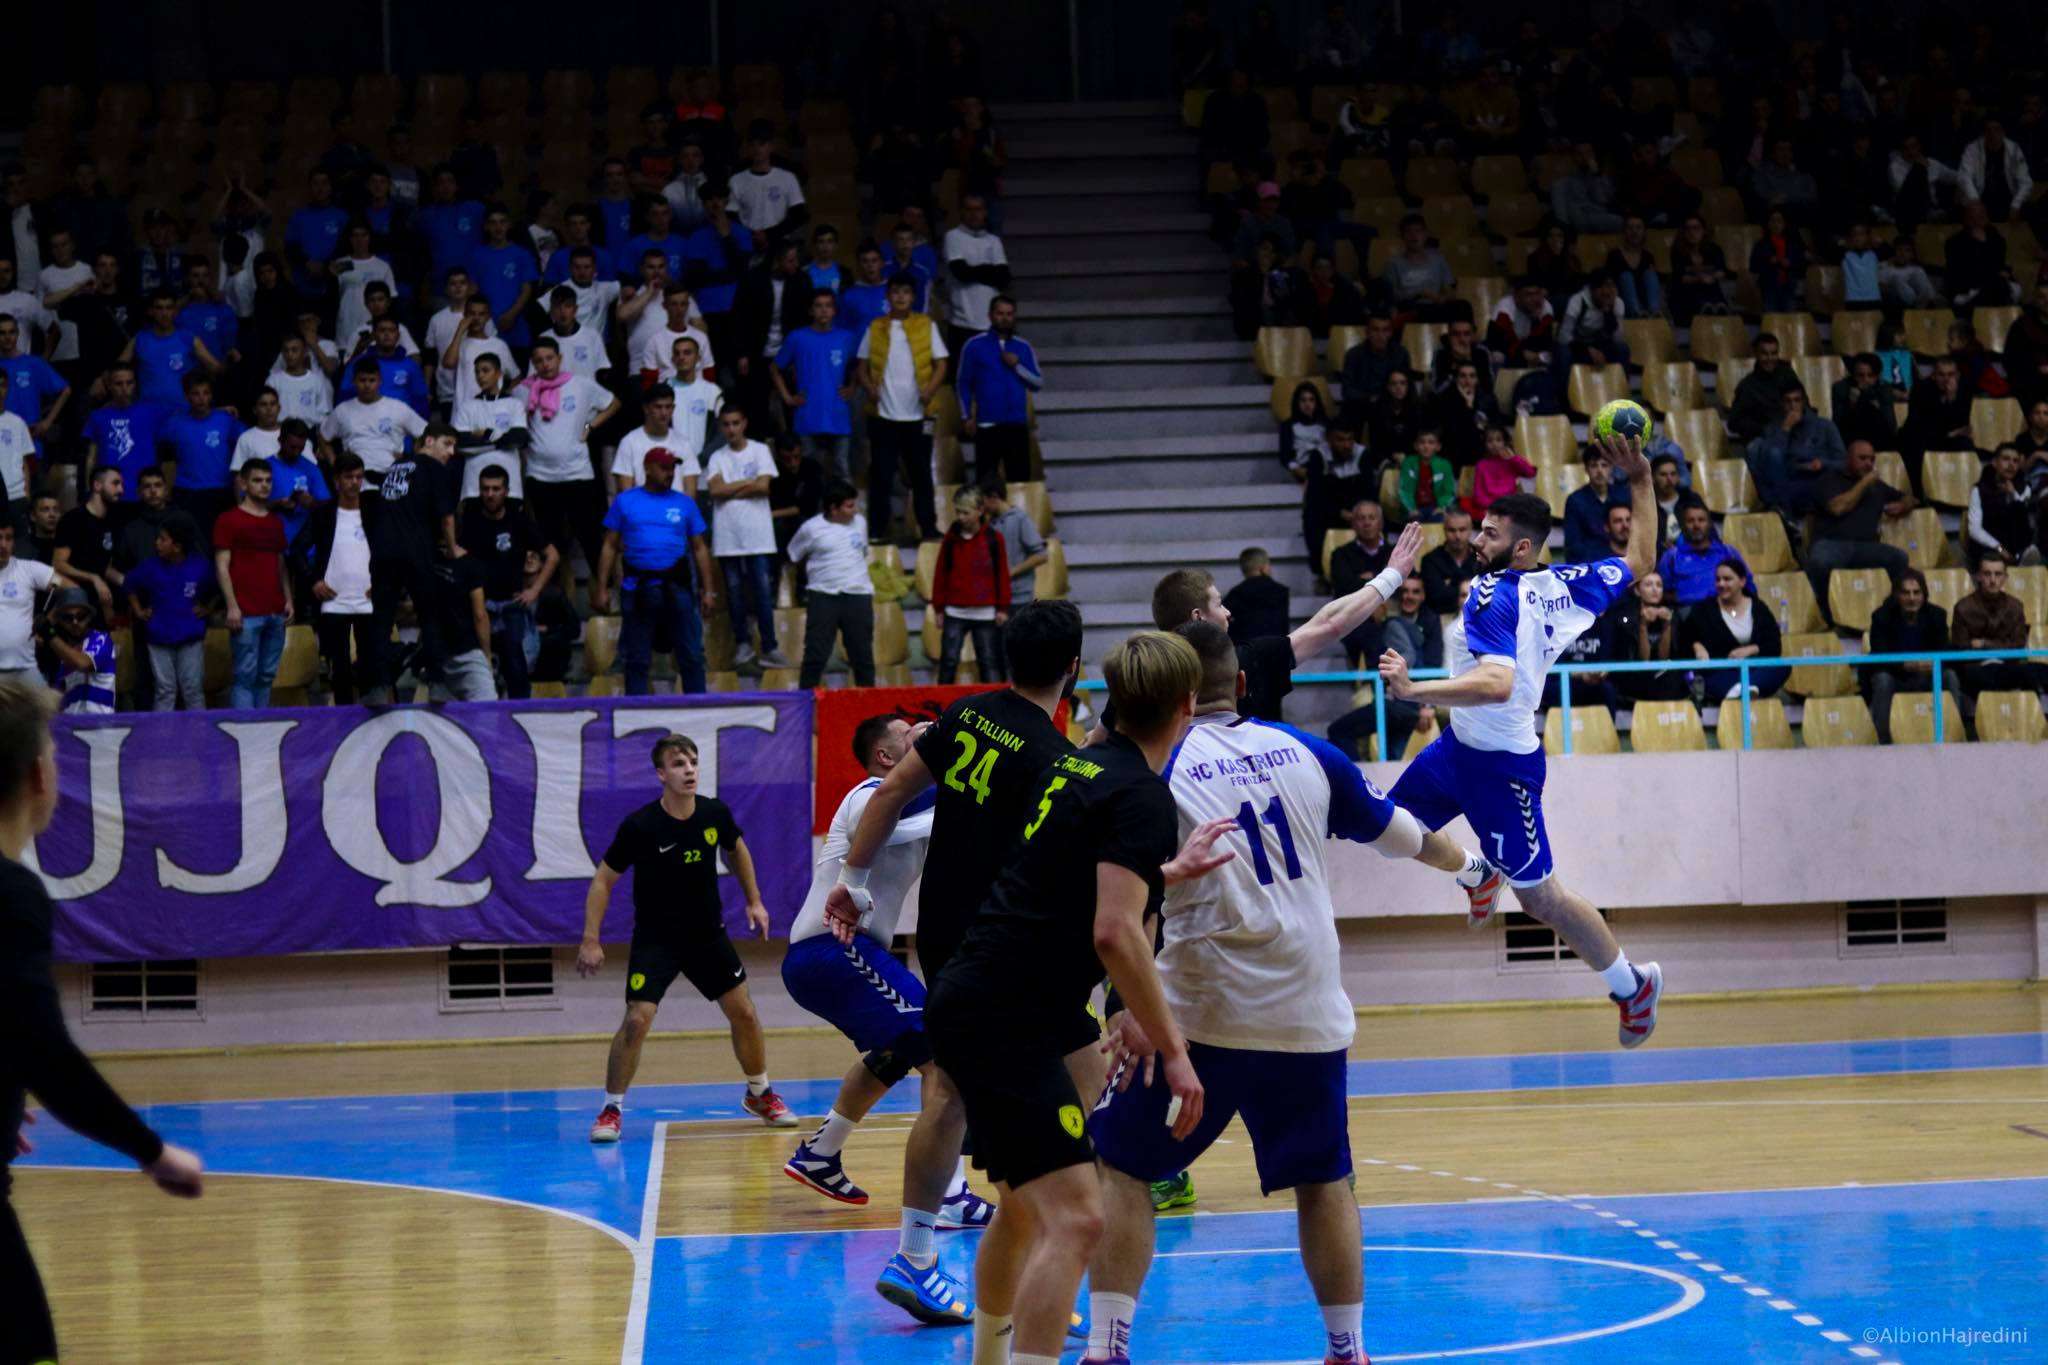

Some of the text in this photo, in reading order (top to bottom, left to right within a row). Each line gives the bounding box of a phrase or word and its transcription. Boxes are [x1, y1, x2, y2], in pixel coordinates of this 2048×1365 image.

[958, 707, 1025, 753] HC TALLINN
[944, 730, 1000, 805] 24
[1186, 748, 1300, 782] HC KASTRIOTI
[1024, 775, 1068, 840] 5
[683, 849, 703, 865] 22
[1232, 795, 1303, 885] 11
[1490, 831, 1504, 860] 7
